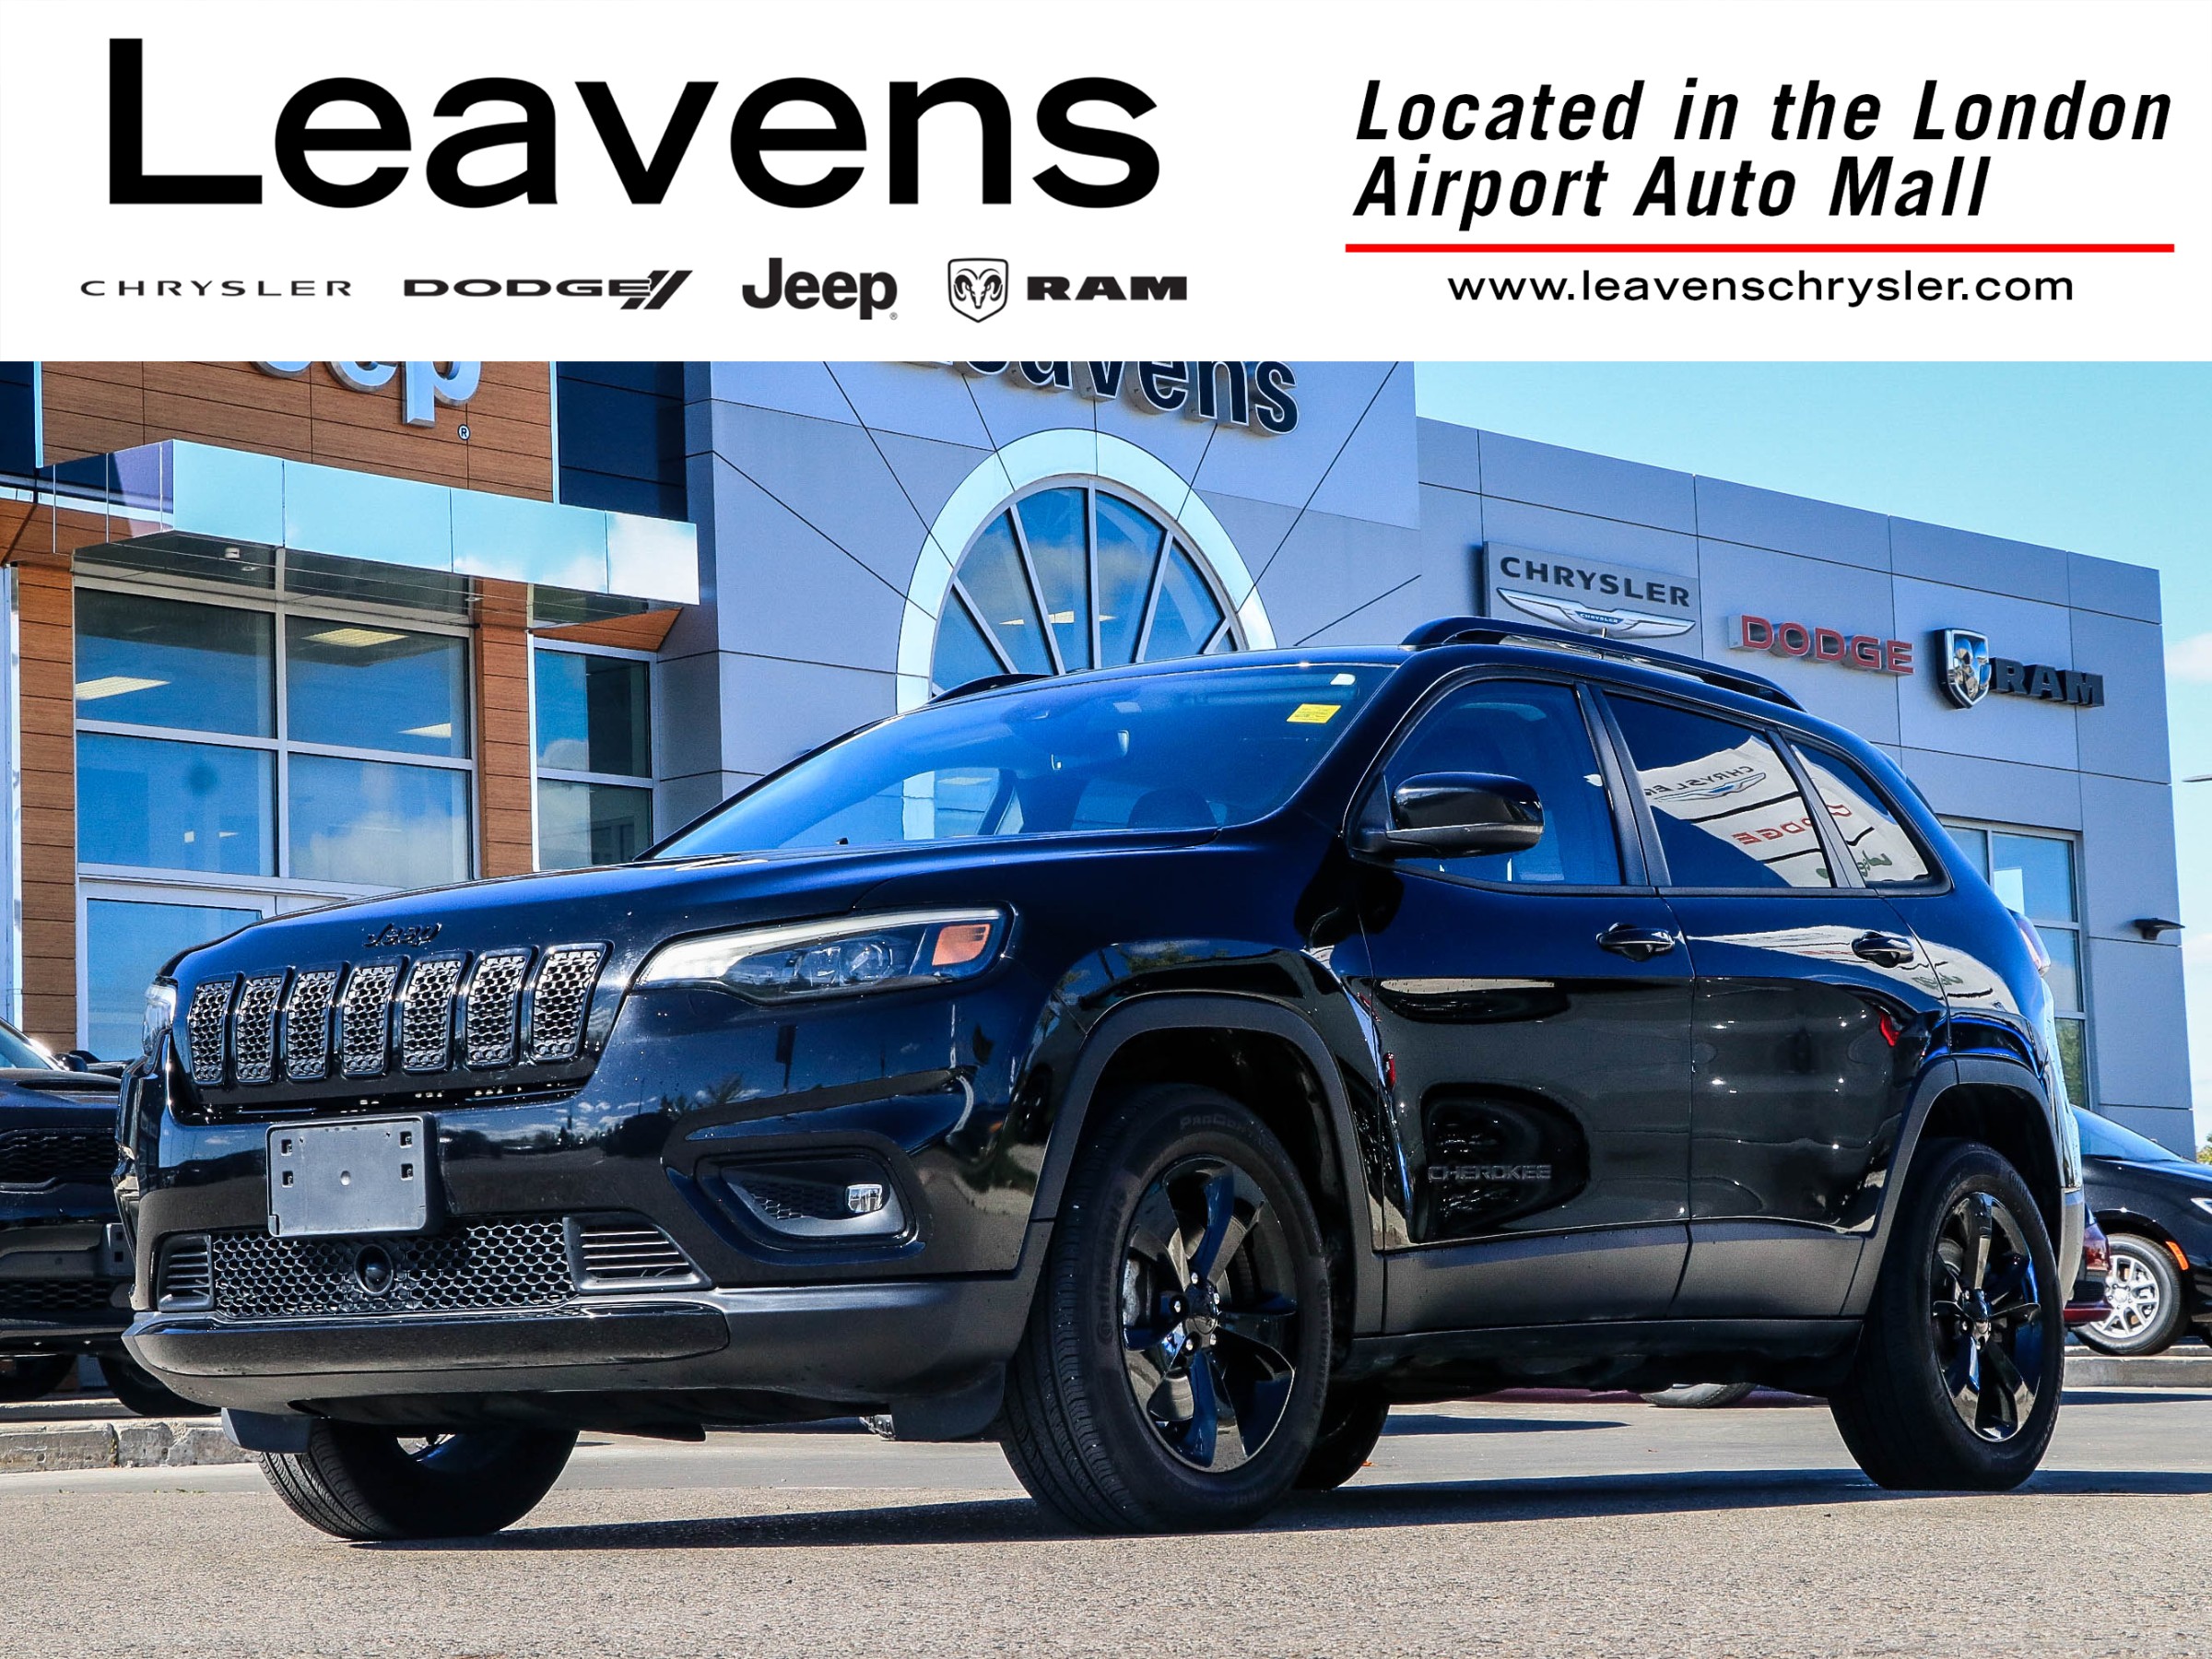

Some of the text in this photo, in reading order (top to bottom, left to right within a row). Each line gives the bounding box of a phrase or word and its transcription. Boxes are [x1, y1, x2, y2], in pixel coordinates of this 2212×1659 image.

[1500, 556, 1690, 608] CHRYSLER
[1580, 612, 1619, 625] CHRYSLER
[1738, 614, 1916, 676] DODGE
[1991, 656, 2105, 708] RAM
[1428, 1164, 1552, 1181] CHEROKEE
